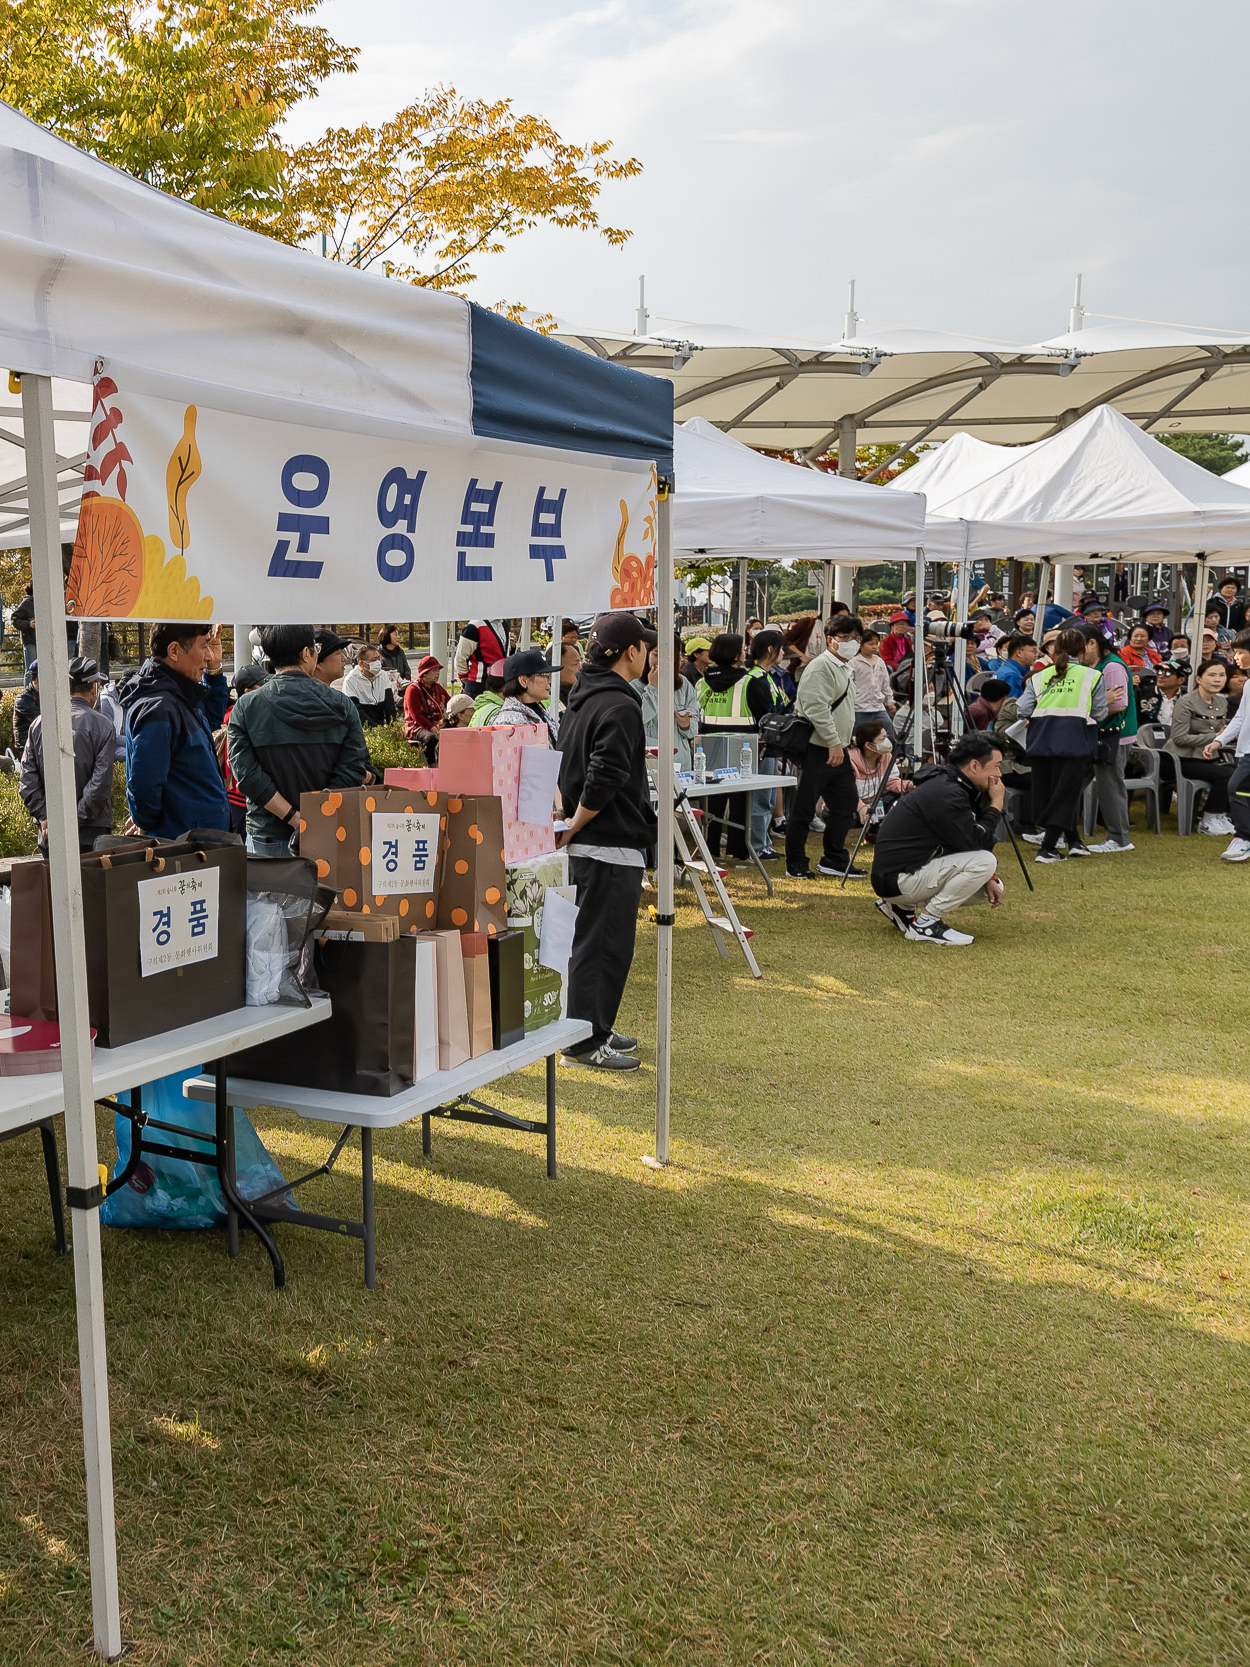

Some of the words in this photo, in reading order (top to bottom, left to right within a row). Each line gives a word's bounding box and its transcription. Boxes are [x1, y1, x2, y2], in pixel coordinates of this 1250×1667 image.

[267, 454, 568, 583] 운영본부
[381, 839, 429, 873] 경품
[151, 898, 209, 947] 경품
[147, 953, 172, 968] 구의제2동
[175, 941, 213, 960] 문화행사위원회
